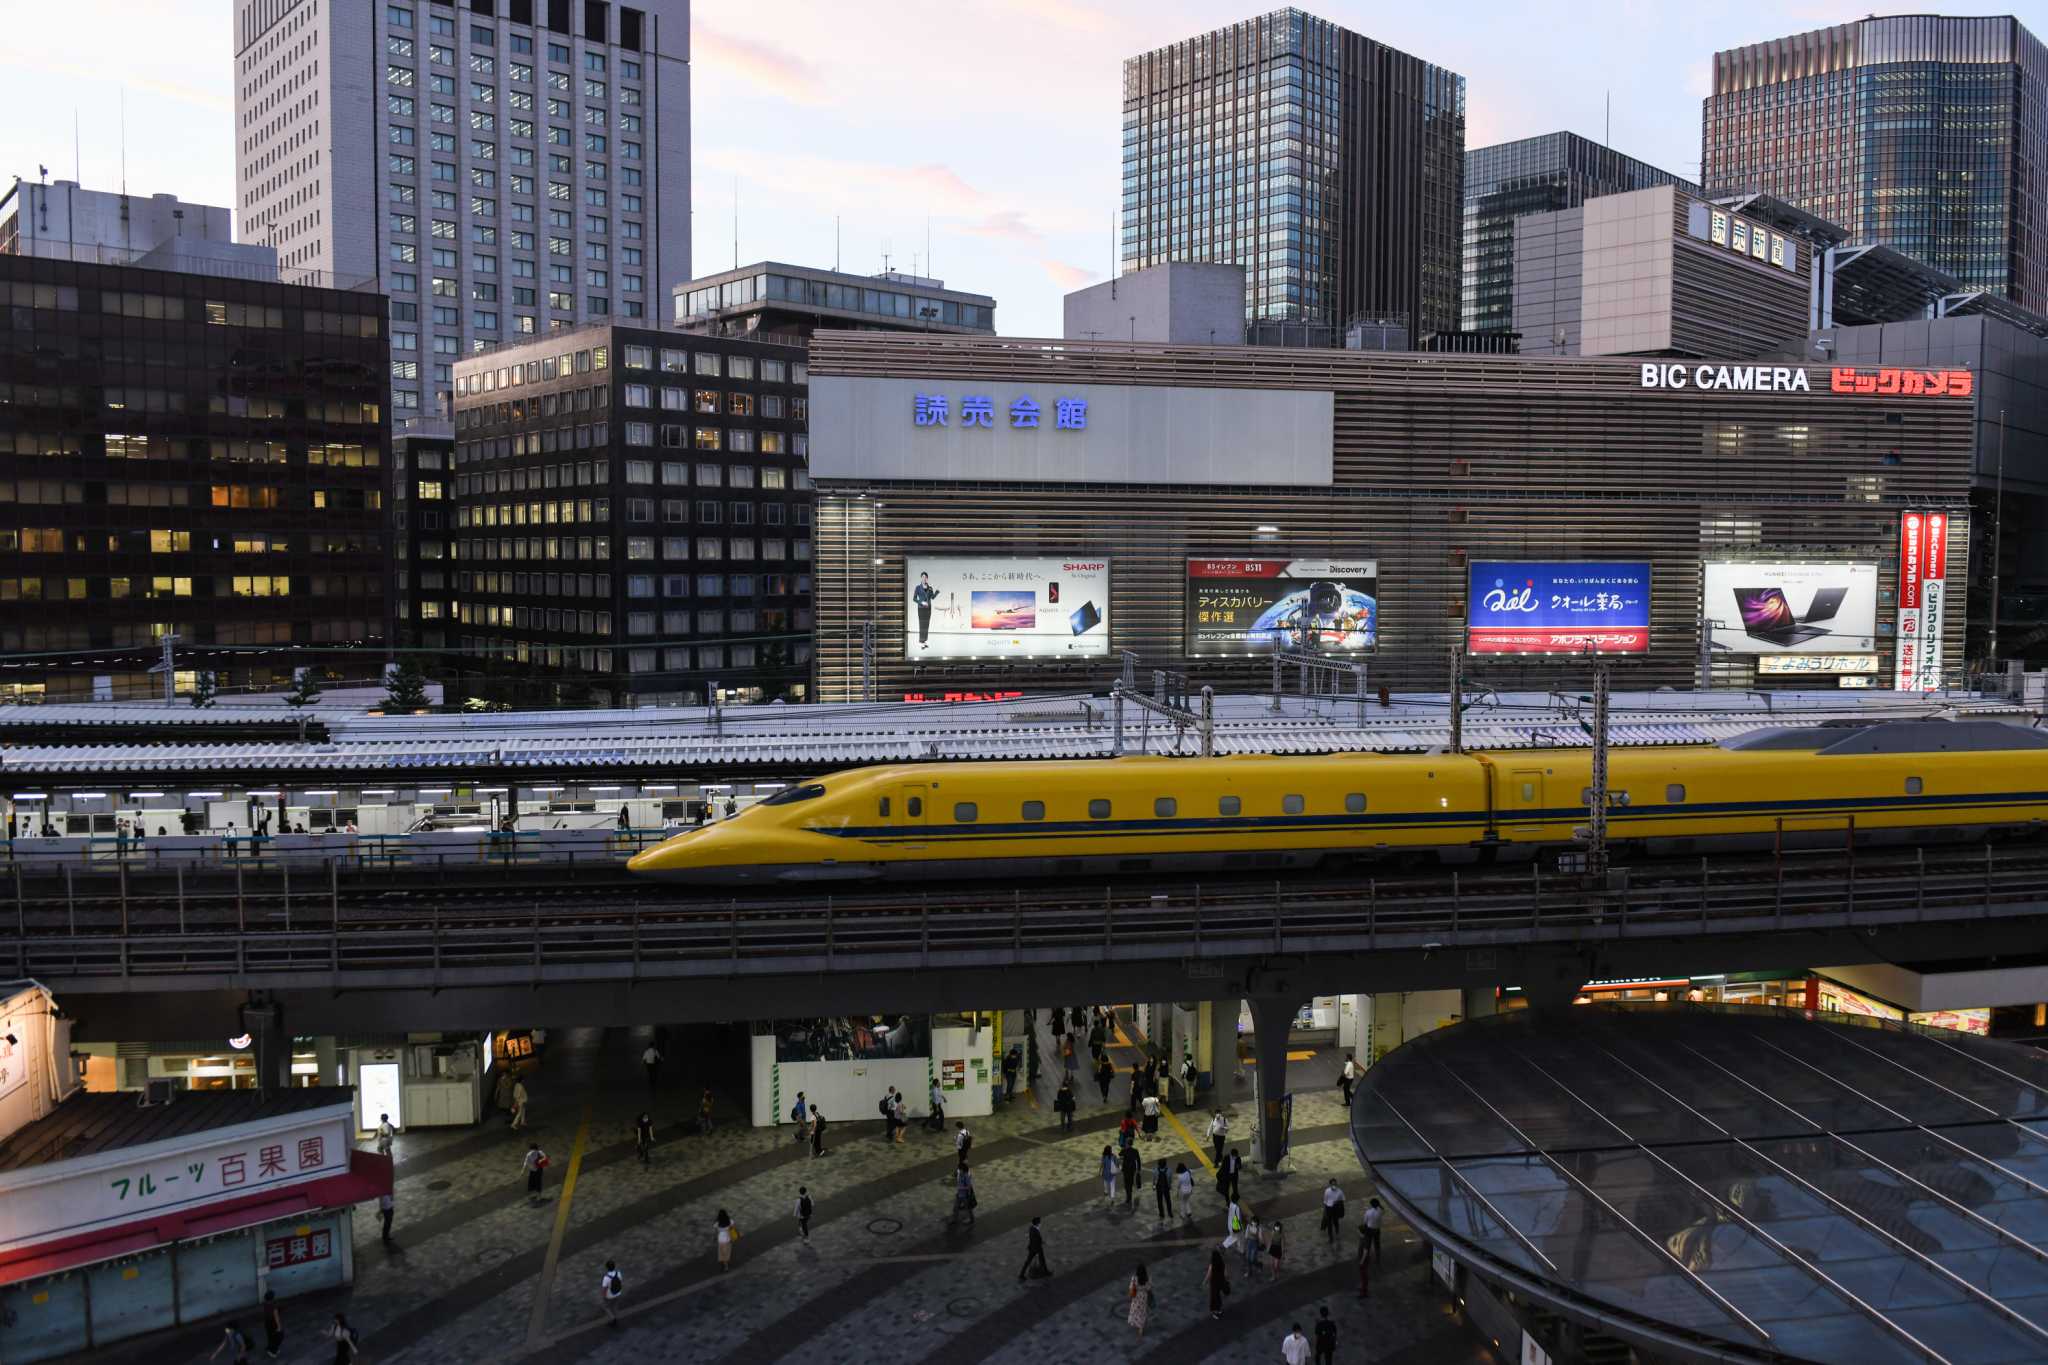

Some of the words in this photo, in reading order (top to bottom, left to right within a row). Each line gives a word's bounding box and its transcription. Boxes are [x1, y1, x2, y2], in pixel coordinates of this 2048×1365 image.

[1713, 213, 1783, 263] 読売新聞
[1641, 363, 1687, 389] BIC
[1695, 365, 1810, 392] CAMERA
[1831, 367, 1973, 396] ビックカメラ
[914, 392, 1088, 430] 読売会館
[1063, 563, 1105, 571] SHARP
[1245, 563, 1262, 573] BS11
[1329, 565, 1368, 575] Discovery
[1199, 596, 1273, 608] ディスカバリー
[1551, 592, 1624, 612] クオール薬局
[1199, 611, 1235, 624] 傑作選
[1781, 656, 1870, 671] よみうりホール
[110, 1162, 204, 1201] フルーツ
[217, 1136, 325, 1187] 百果園
[267, 1231, 331, 1266] 百果園
